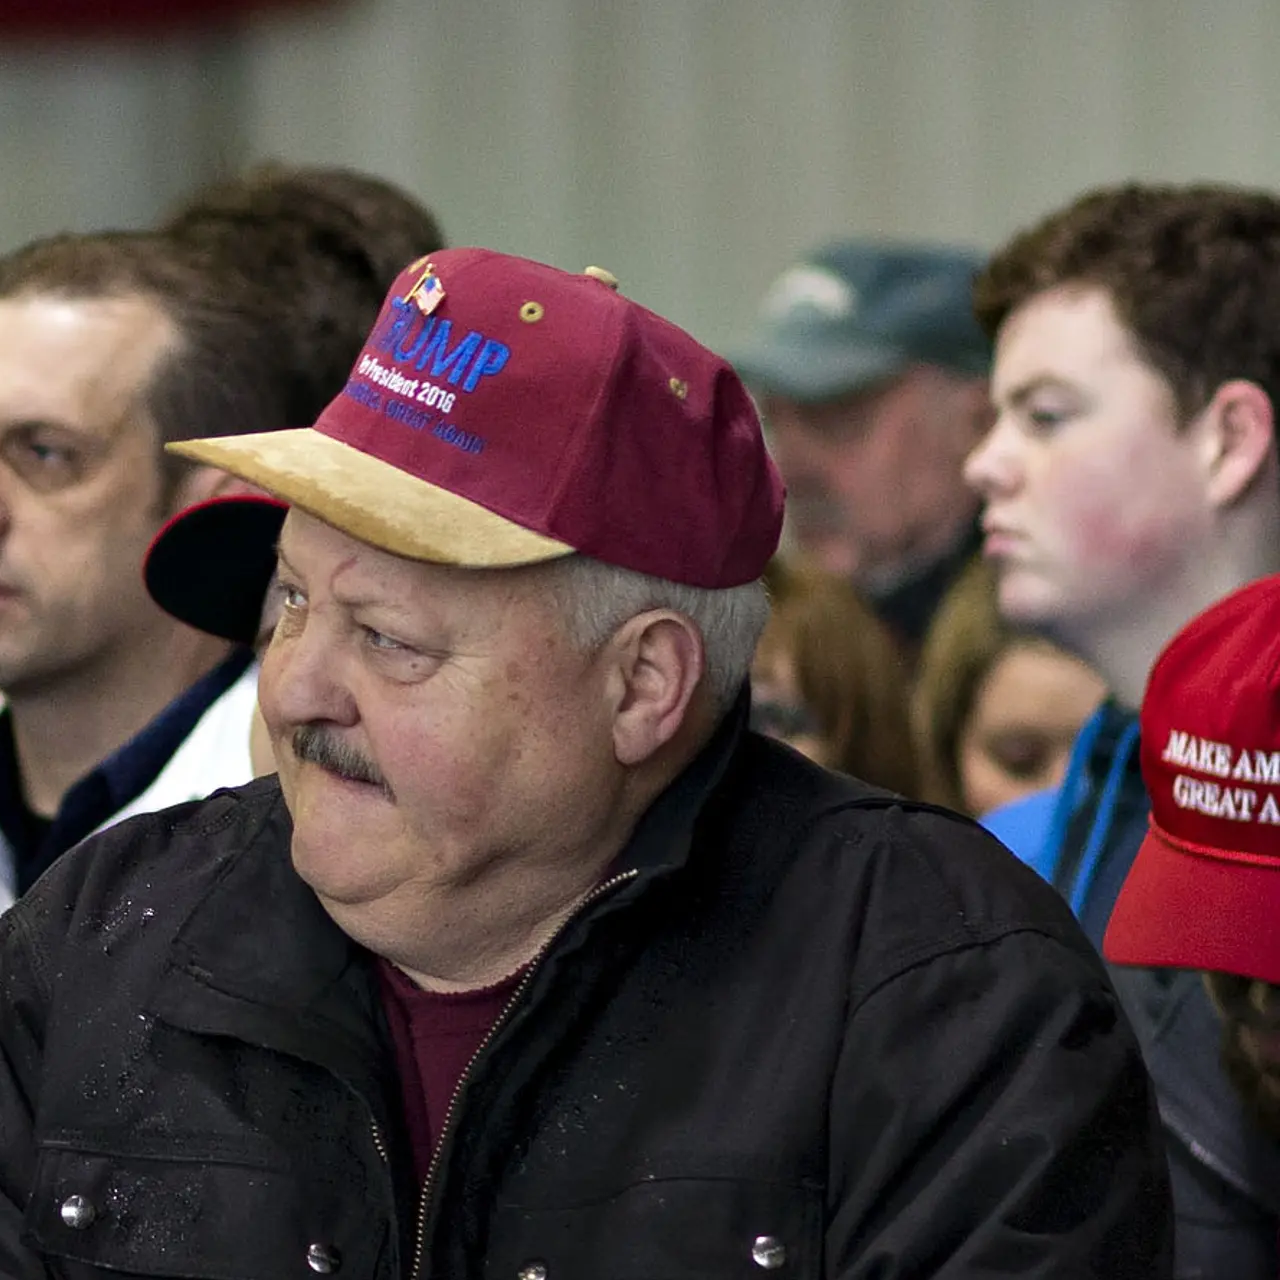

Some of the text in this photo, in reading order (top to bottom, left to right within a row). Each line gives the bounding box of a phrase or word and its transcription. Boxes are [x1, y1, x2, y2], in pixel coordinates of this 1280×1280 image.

[416, 381, 456, 413] 2016
[1162, 729, 1232, 778] MAKE
[1172, 775, 1257, 821] GREAT
